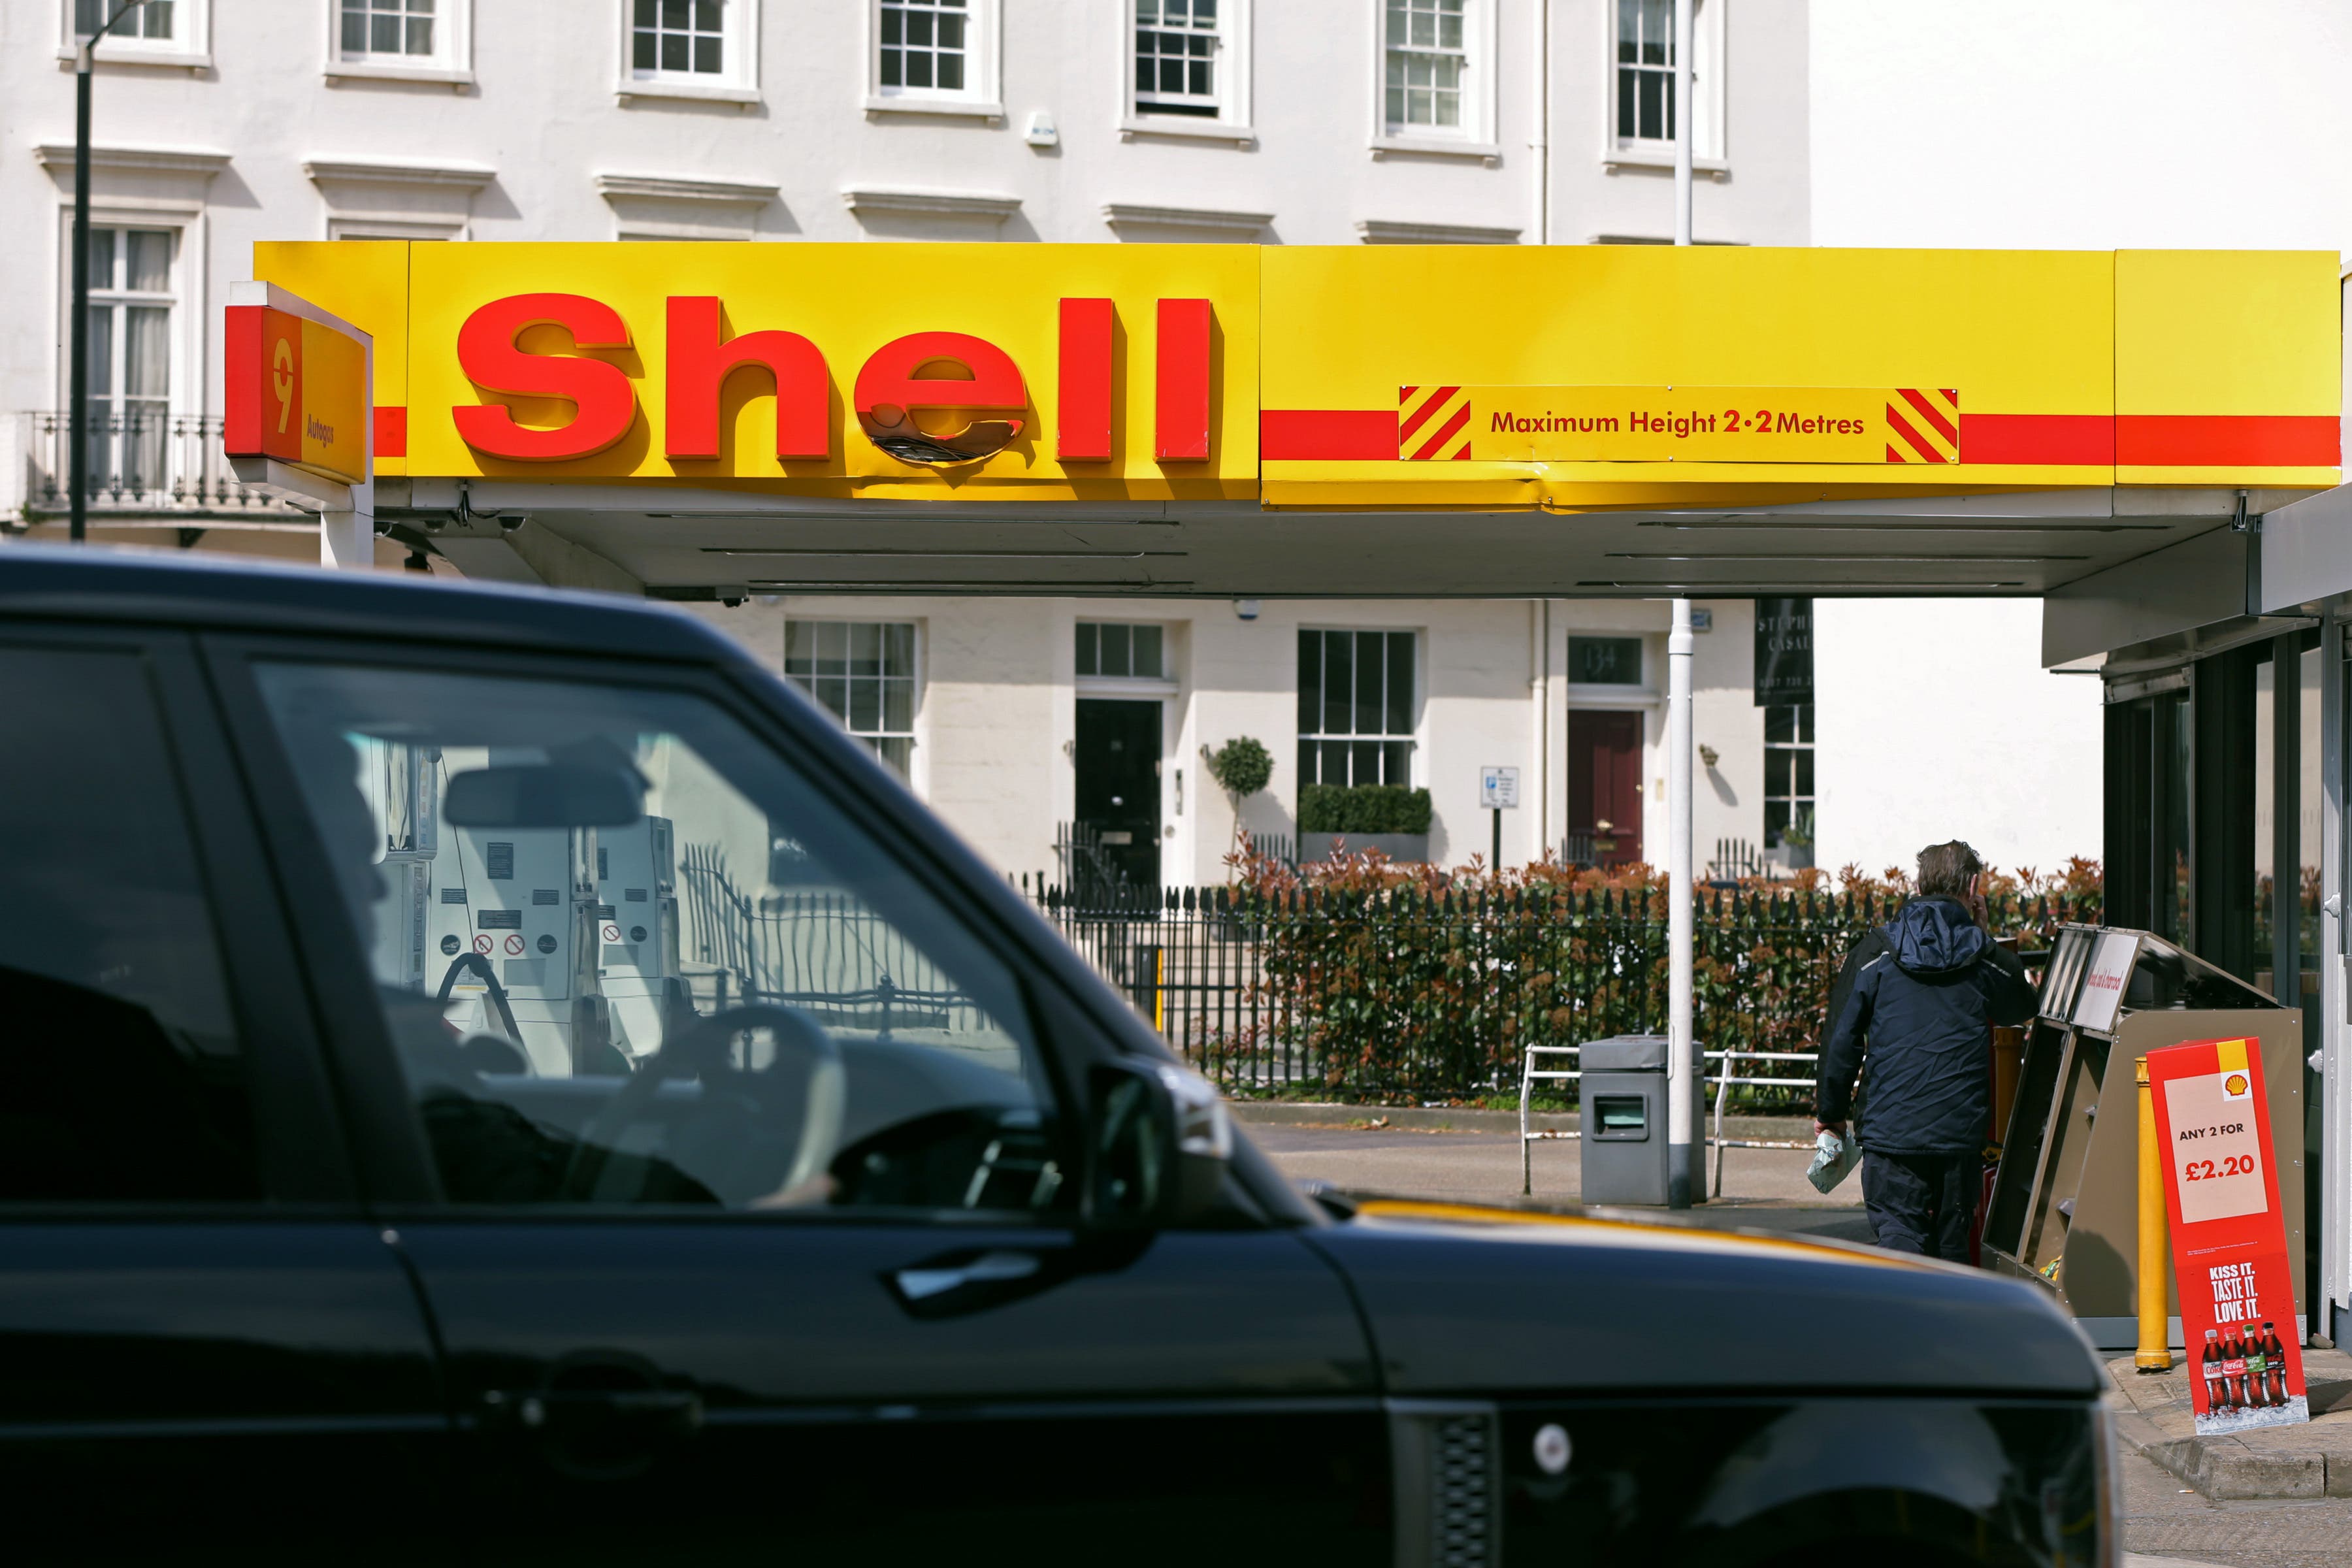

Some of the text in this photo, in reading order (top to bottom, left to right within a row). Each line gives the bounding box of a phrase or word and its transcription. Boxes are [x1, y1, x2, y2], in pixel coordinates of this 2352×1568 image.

[273, 337, 293, 434] 9
[451, 292, 1213, 468] Shell
[307, 414, 334, 448] Autogas
[1491, 411, 1619, 433] Maximum
[1630, 411, 1716, 438] Height
[1776, 412, 1864, 434] Metres
[2180, 1123, 2244, 1141] ANY 2 FOR
[2185, 1154, 2254, 1181] £2.20
[2210, 1262, 2255, 1280] KISS IT.
[2211, 1276, 2258, 1301] TASTE IT.
[2214, 1298, 2261, 1324] LOVE IT.
